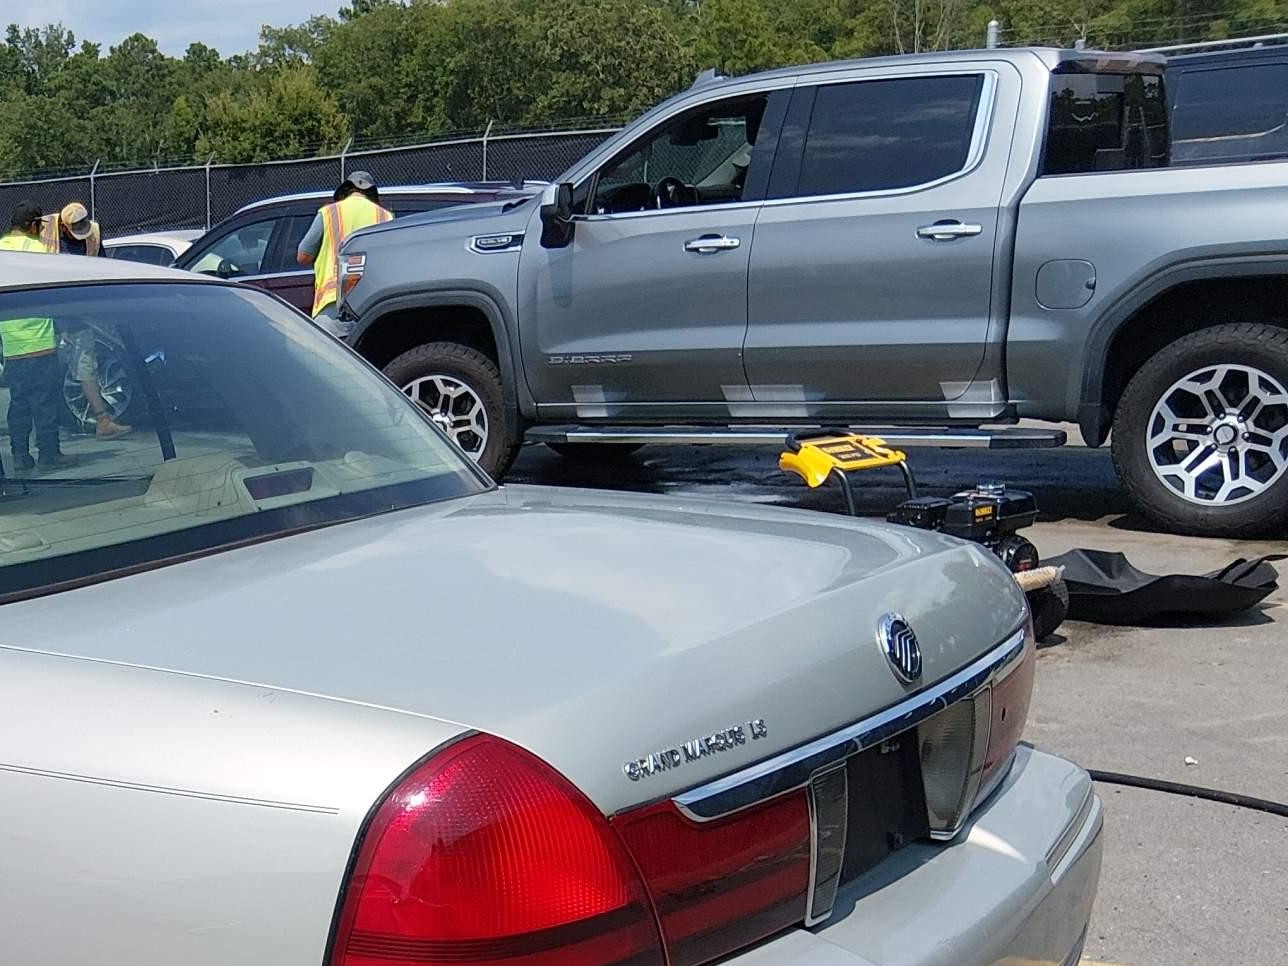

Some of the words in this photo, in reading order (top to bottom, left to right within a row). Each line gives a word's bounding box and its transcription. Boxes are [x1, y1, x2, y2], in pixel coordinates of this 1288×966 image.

[623, 749, 681, 782] GRAND
[680, 725, 747, 764] MARQUIS
[746, 718, 768, 741] LS
